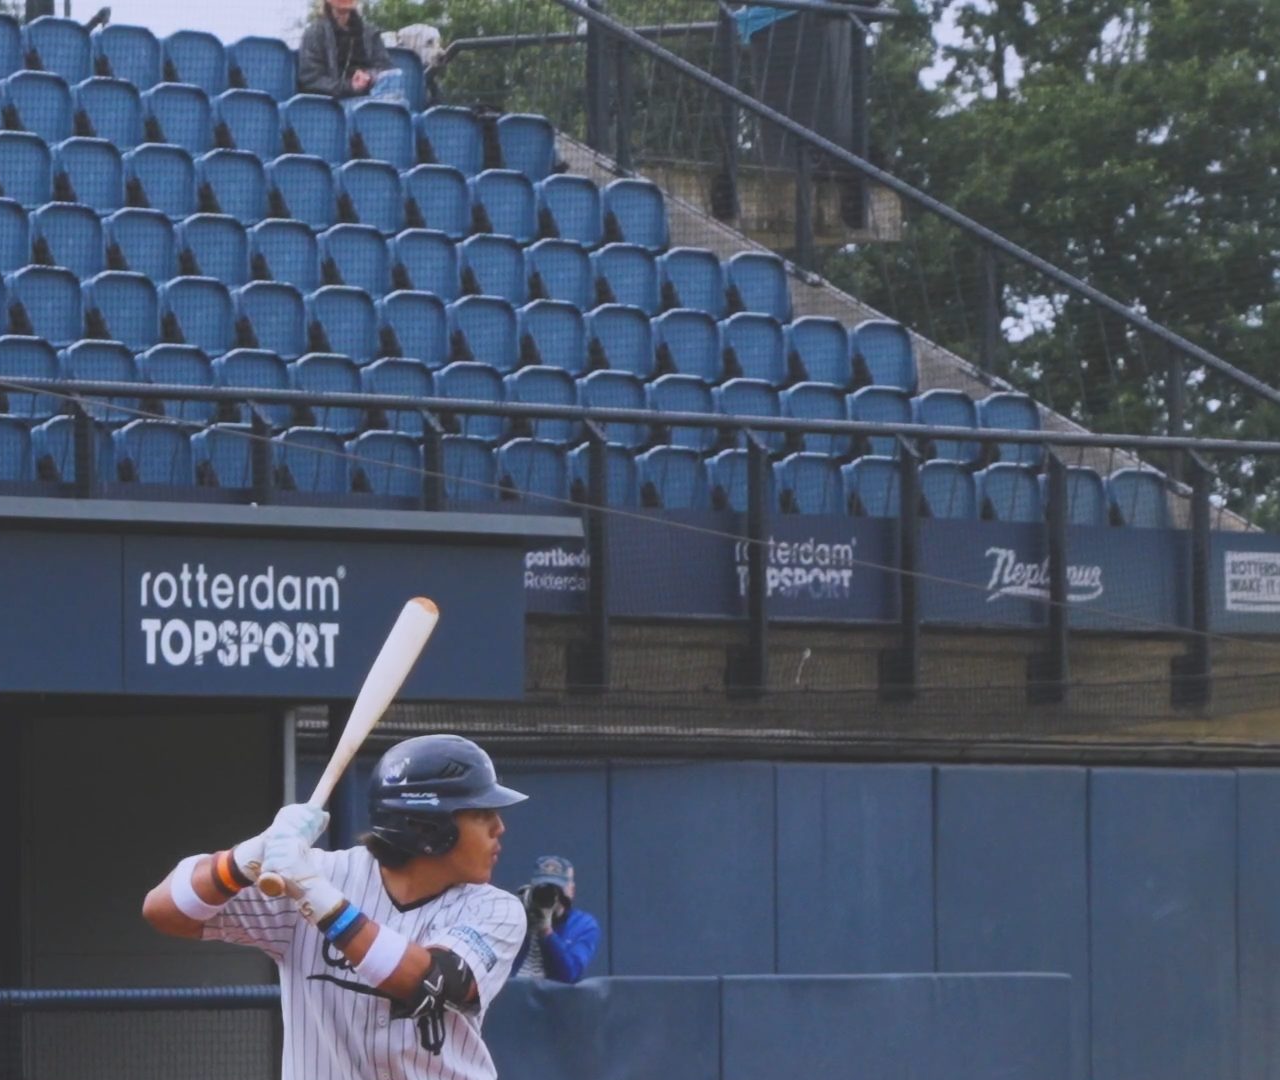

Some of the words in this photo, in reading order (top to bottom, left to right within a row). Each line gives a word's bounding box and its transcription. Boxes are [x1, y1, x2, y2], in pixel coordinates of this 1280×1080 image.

[736, 565, 853, 599] TPSPORT
[985, 546, 1102, 594] Neptnus
[140, 618, 340, 668] TOPSPORT
